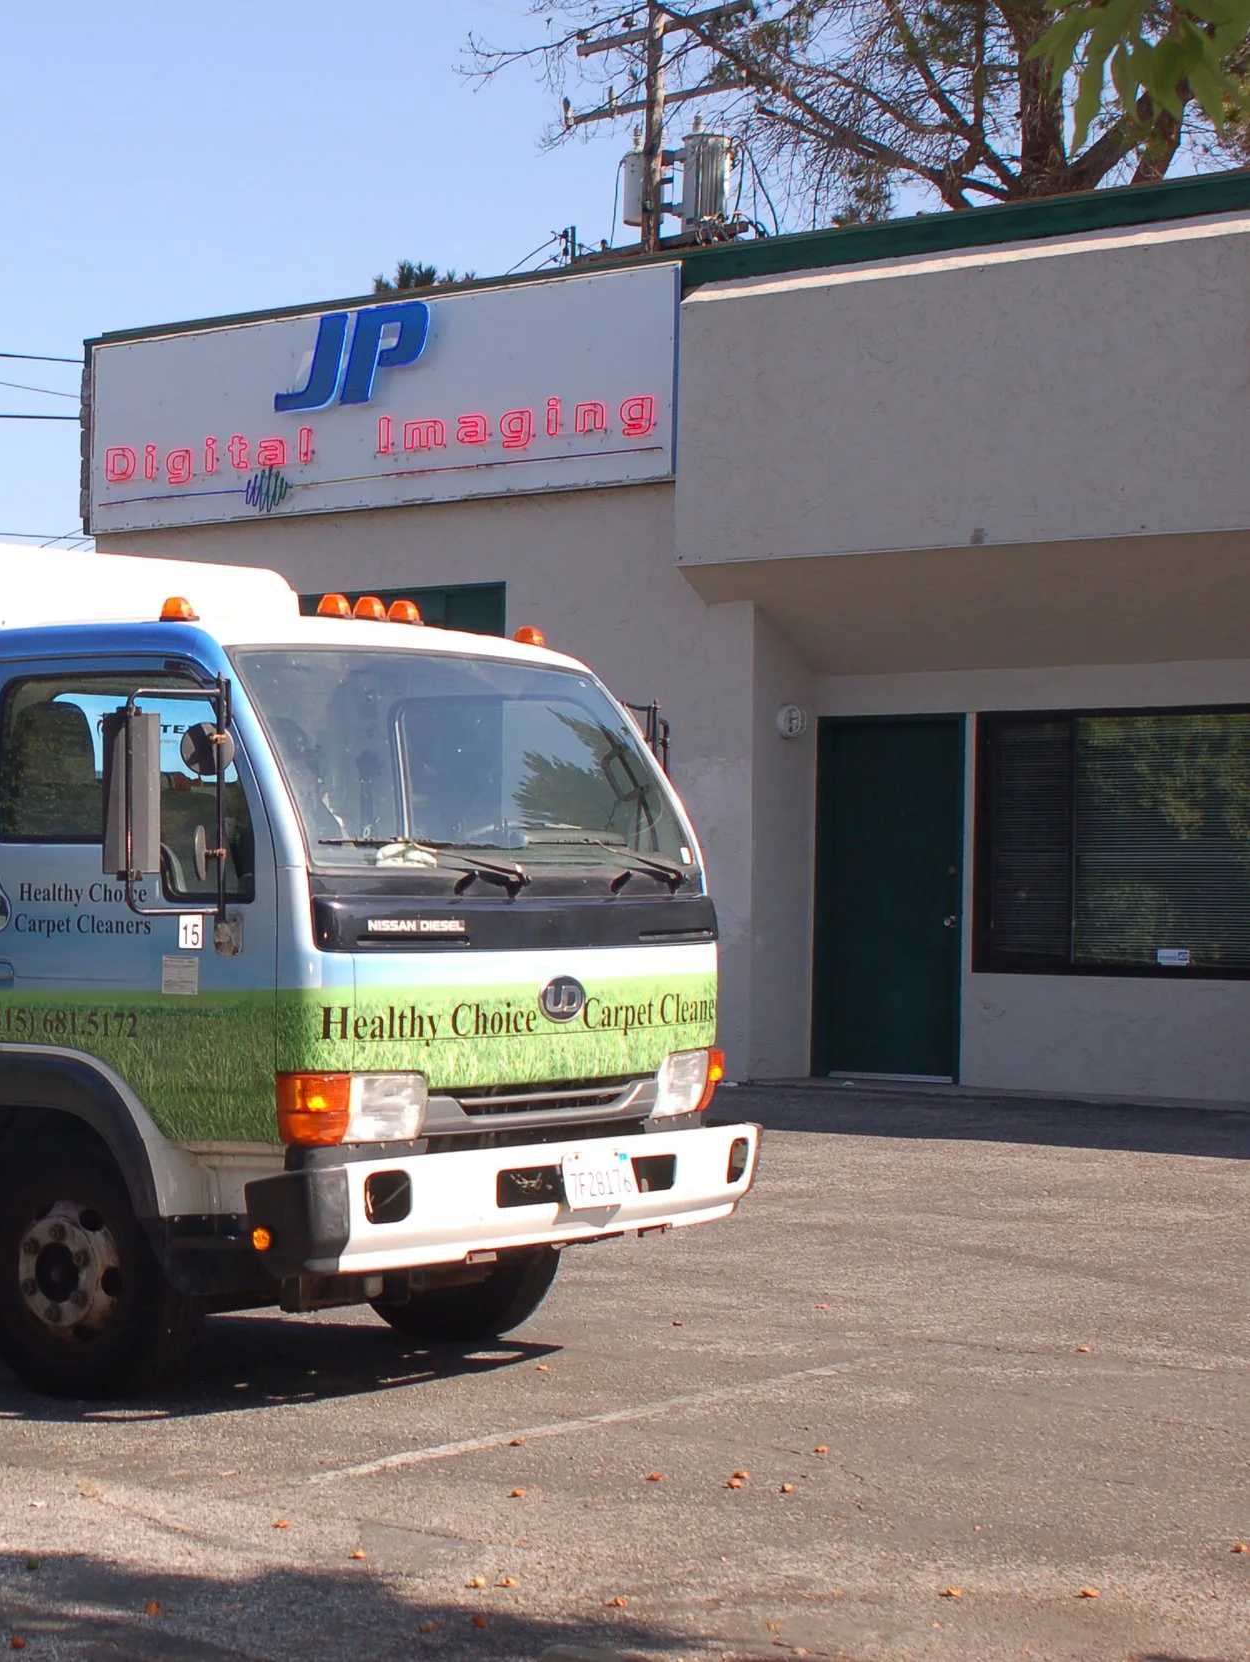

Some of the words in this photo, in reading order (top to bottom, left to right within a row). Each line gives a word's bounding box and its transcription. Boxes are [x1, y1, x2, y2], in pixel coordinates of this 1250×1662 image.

[274, 301, 430, 412] JP
[105, 427, 312, 483] Digital
[378, 395, 655, 453] Imaging
[19, 882, 83, 907] Healthy
[88, 882, 147, 903] Choce
[14, 913, 72, 938] Carpet
[76, 913, 151, 935] Cleaners
[182, 923, 200, 946] 15
[367, 919, 417, 932] NISSAN
[419, 919, 466, 932] DIESEL
[546, 985, 582, 1013] UD
[42, 1010, 138, 1038] 681.5172
[320, 1005, 442, 1046] Healthy
[451, 1002, 538, 1037] Choice
[583, 996, 654, 1036] Carpet
[660, 993, 715, 1025] Cleane
